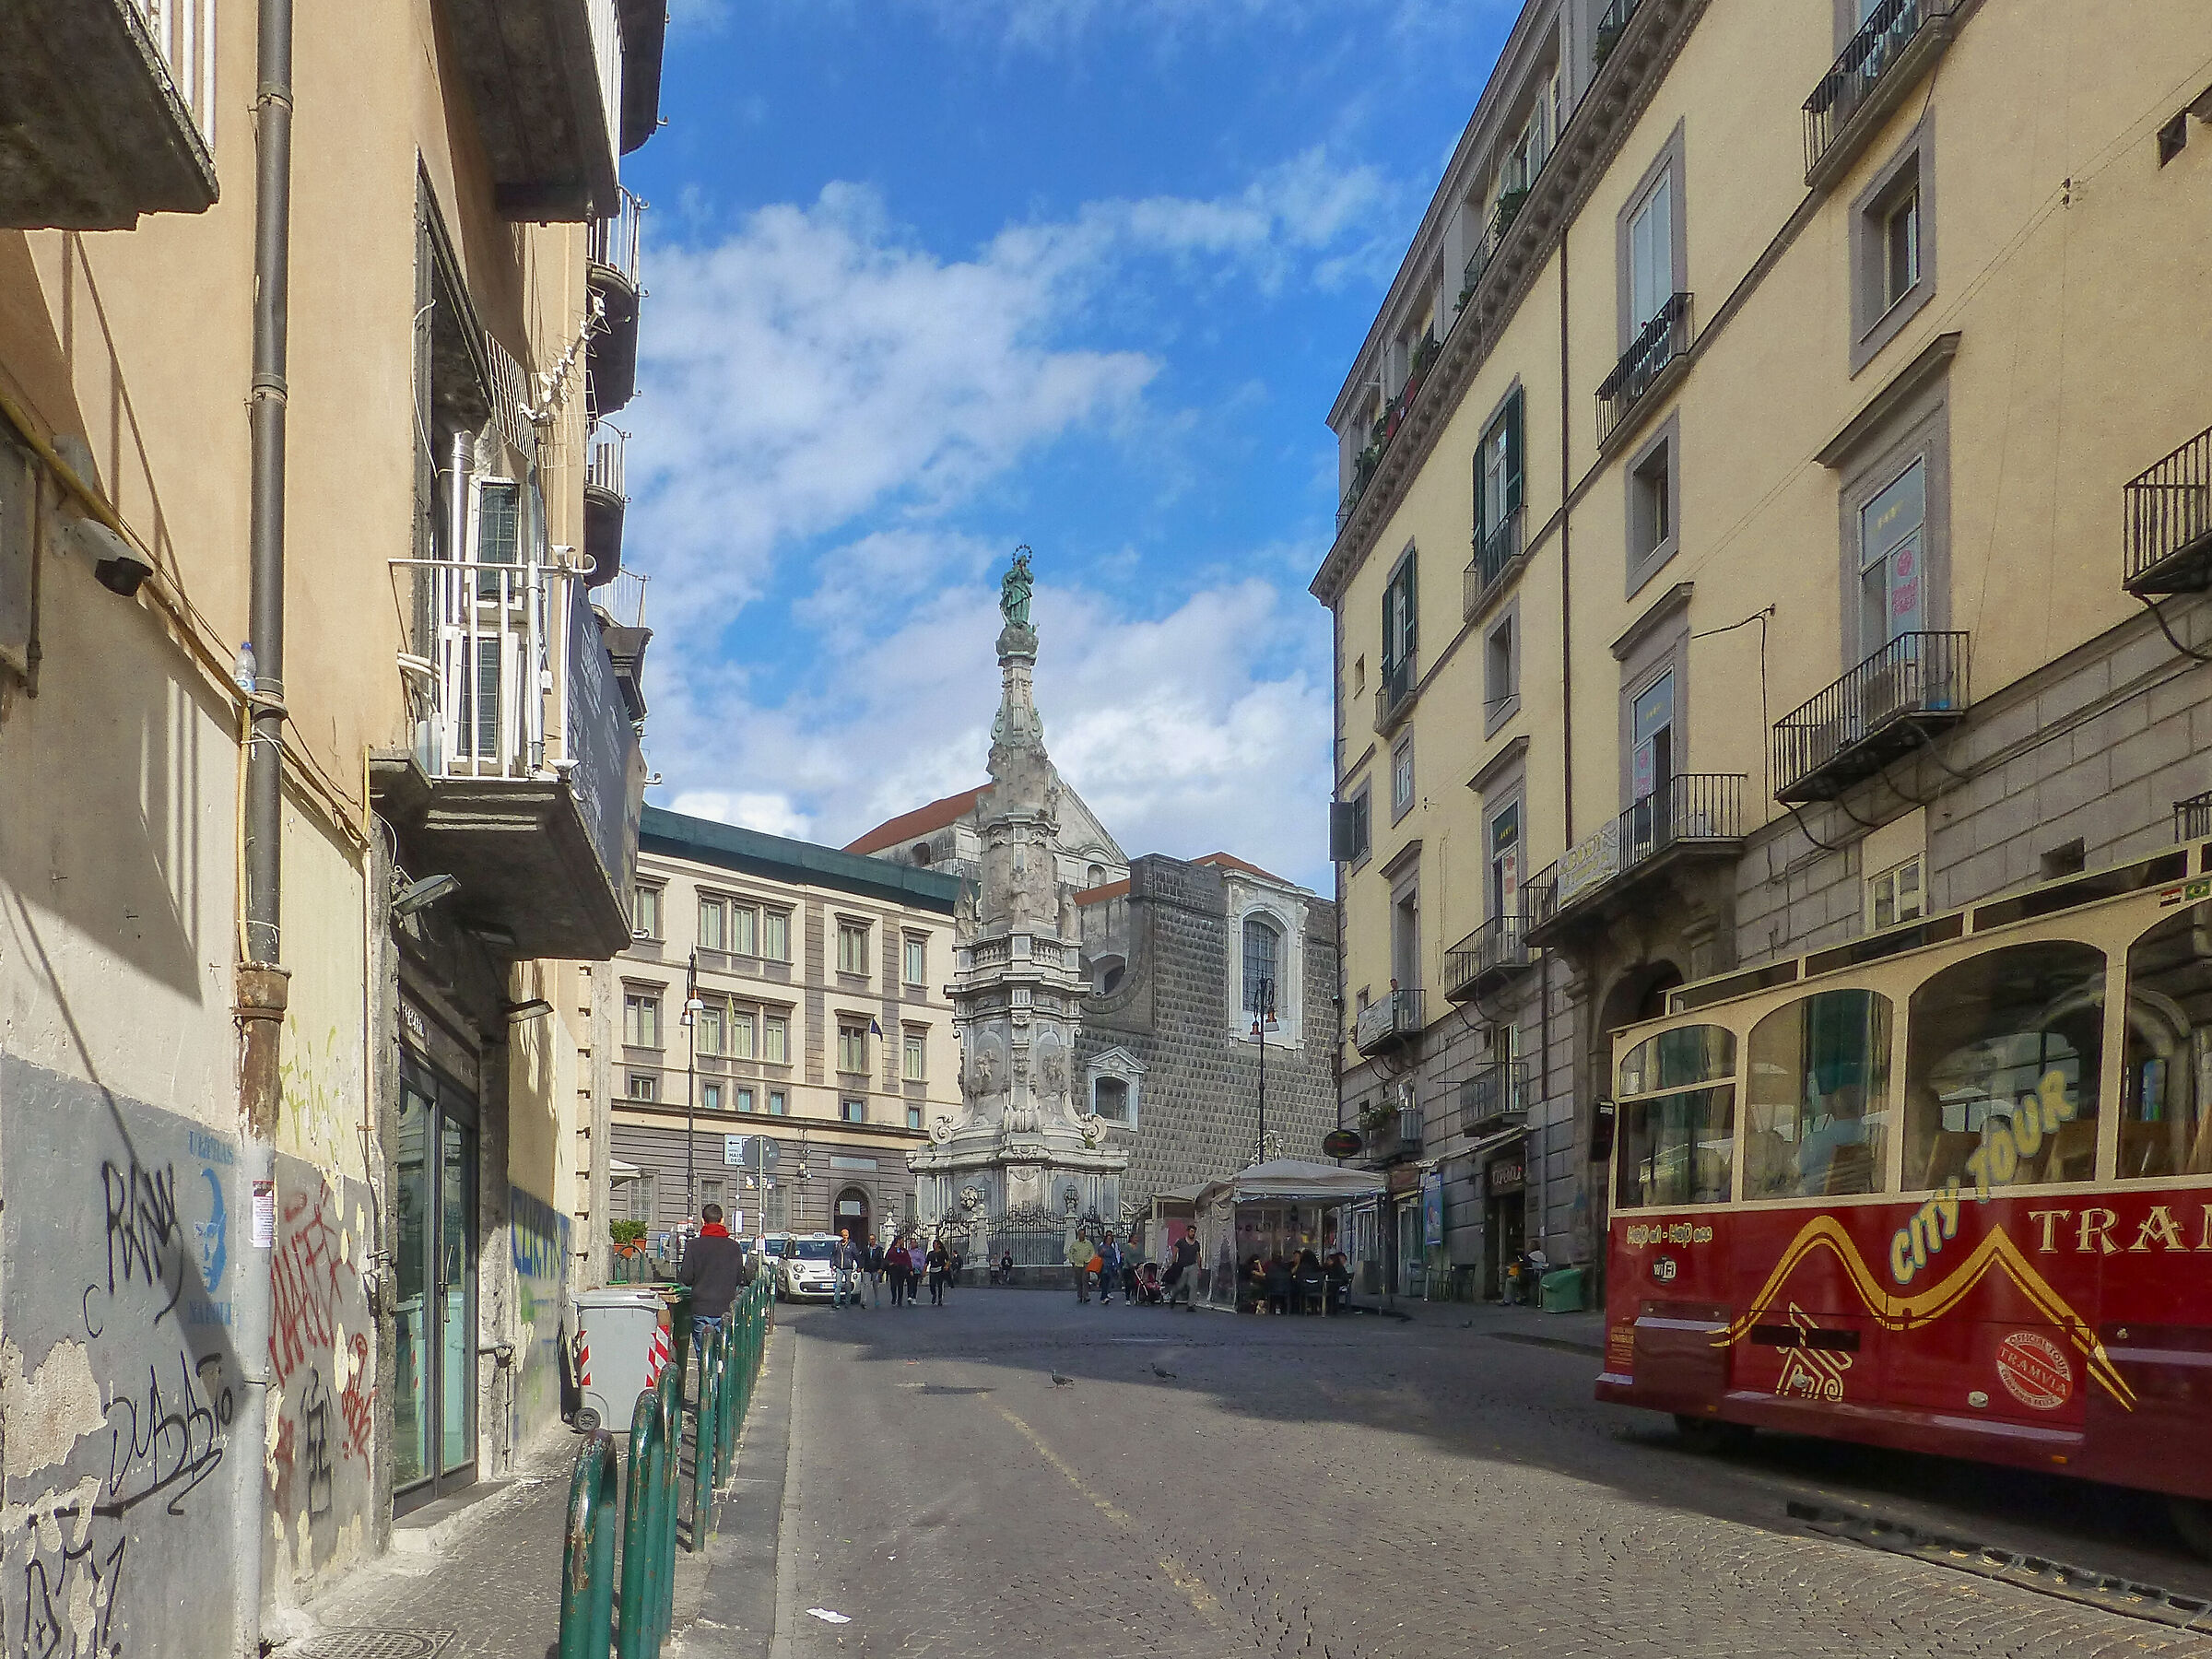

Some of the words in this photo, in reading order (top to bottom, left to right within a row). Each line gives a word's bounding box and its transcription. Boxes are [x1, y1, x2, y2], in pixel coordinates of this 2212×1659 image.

[1890, 1176, 1959, 1285] CITY
[1968, 1069, 2075, 1204] TOUR
[2000, 1346, 2066, 1396] TRAMVIA
